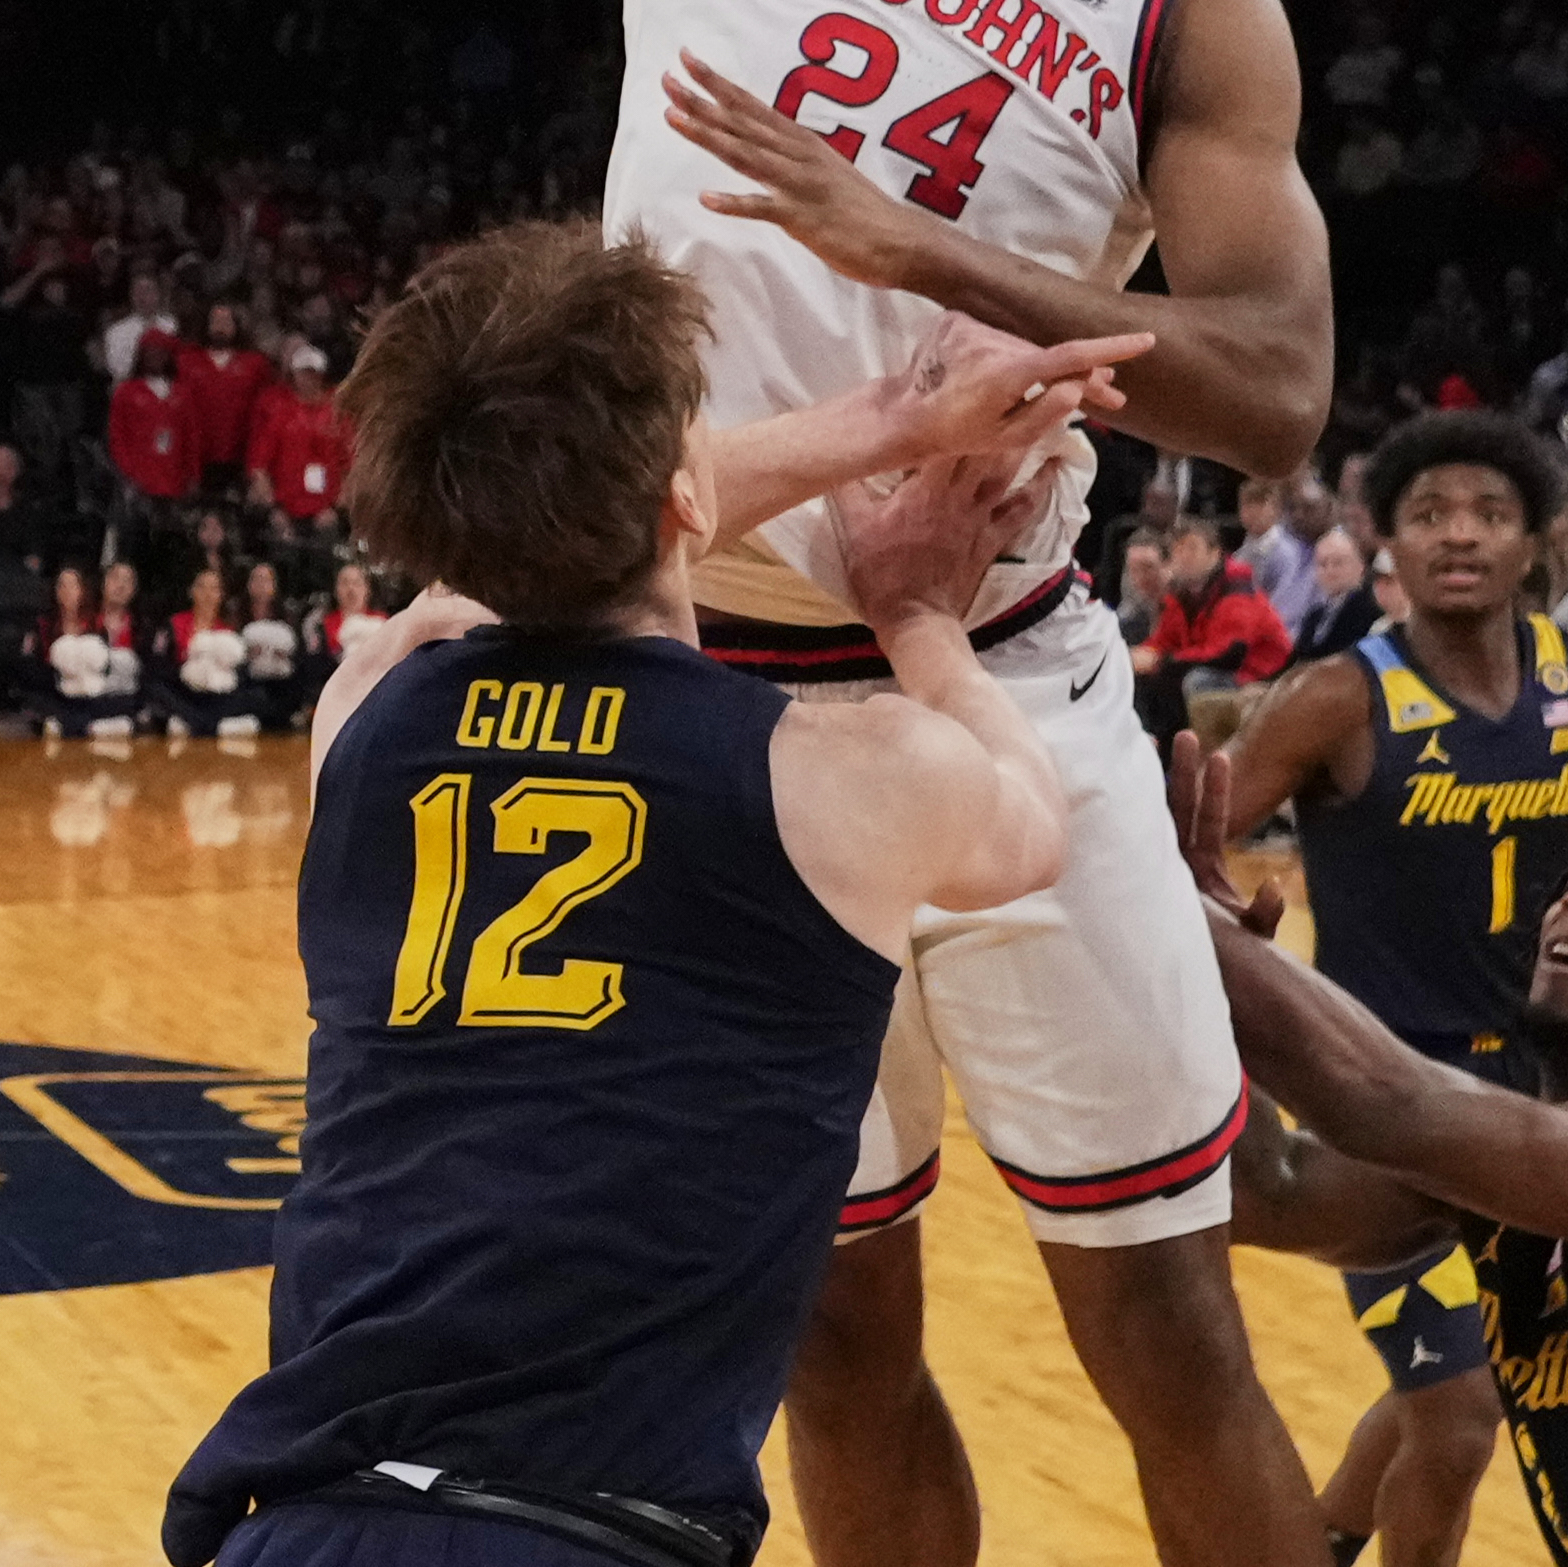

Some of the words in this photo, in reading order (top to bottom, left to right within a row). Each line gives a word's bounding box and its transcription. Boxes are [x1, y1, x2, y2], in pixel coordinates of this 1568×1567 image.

[772, 11, 1016, 222] 24
[455, 678, 627, 756] GOLD
[386, 772, 648, 1032] 12
[1490, 835, 1518, 934] 1
